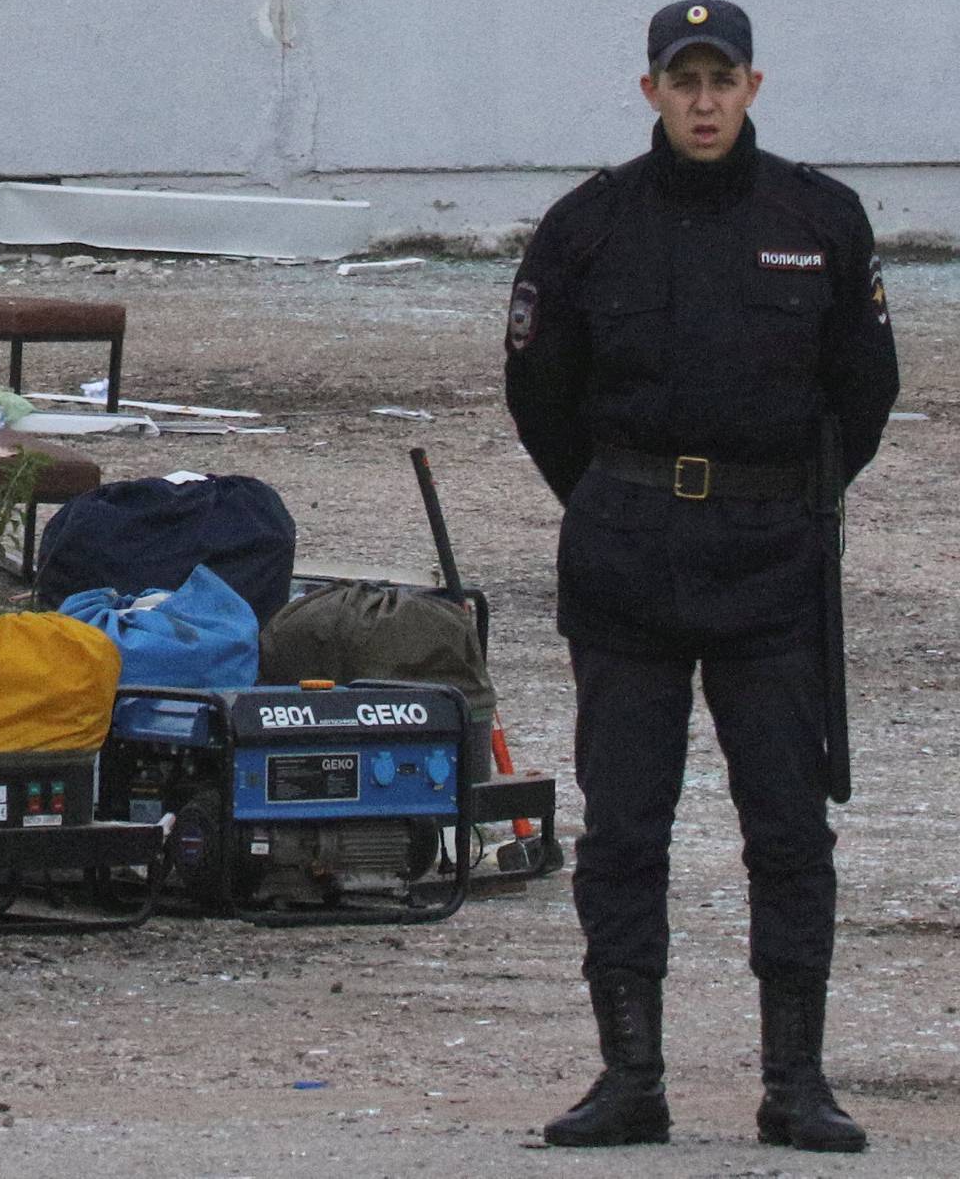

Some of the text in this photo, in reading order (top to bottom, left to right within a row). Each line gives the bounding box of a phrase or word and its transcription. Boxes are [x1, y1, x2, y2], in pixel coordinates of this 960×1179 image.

[761, 251, 822, 268] ПОЛИЦИЯ
[259, 705, 316, 727] 2801
[356, 702, 429, 726] GEKO
[321, 758, 355, 771] GEKO
